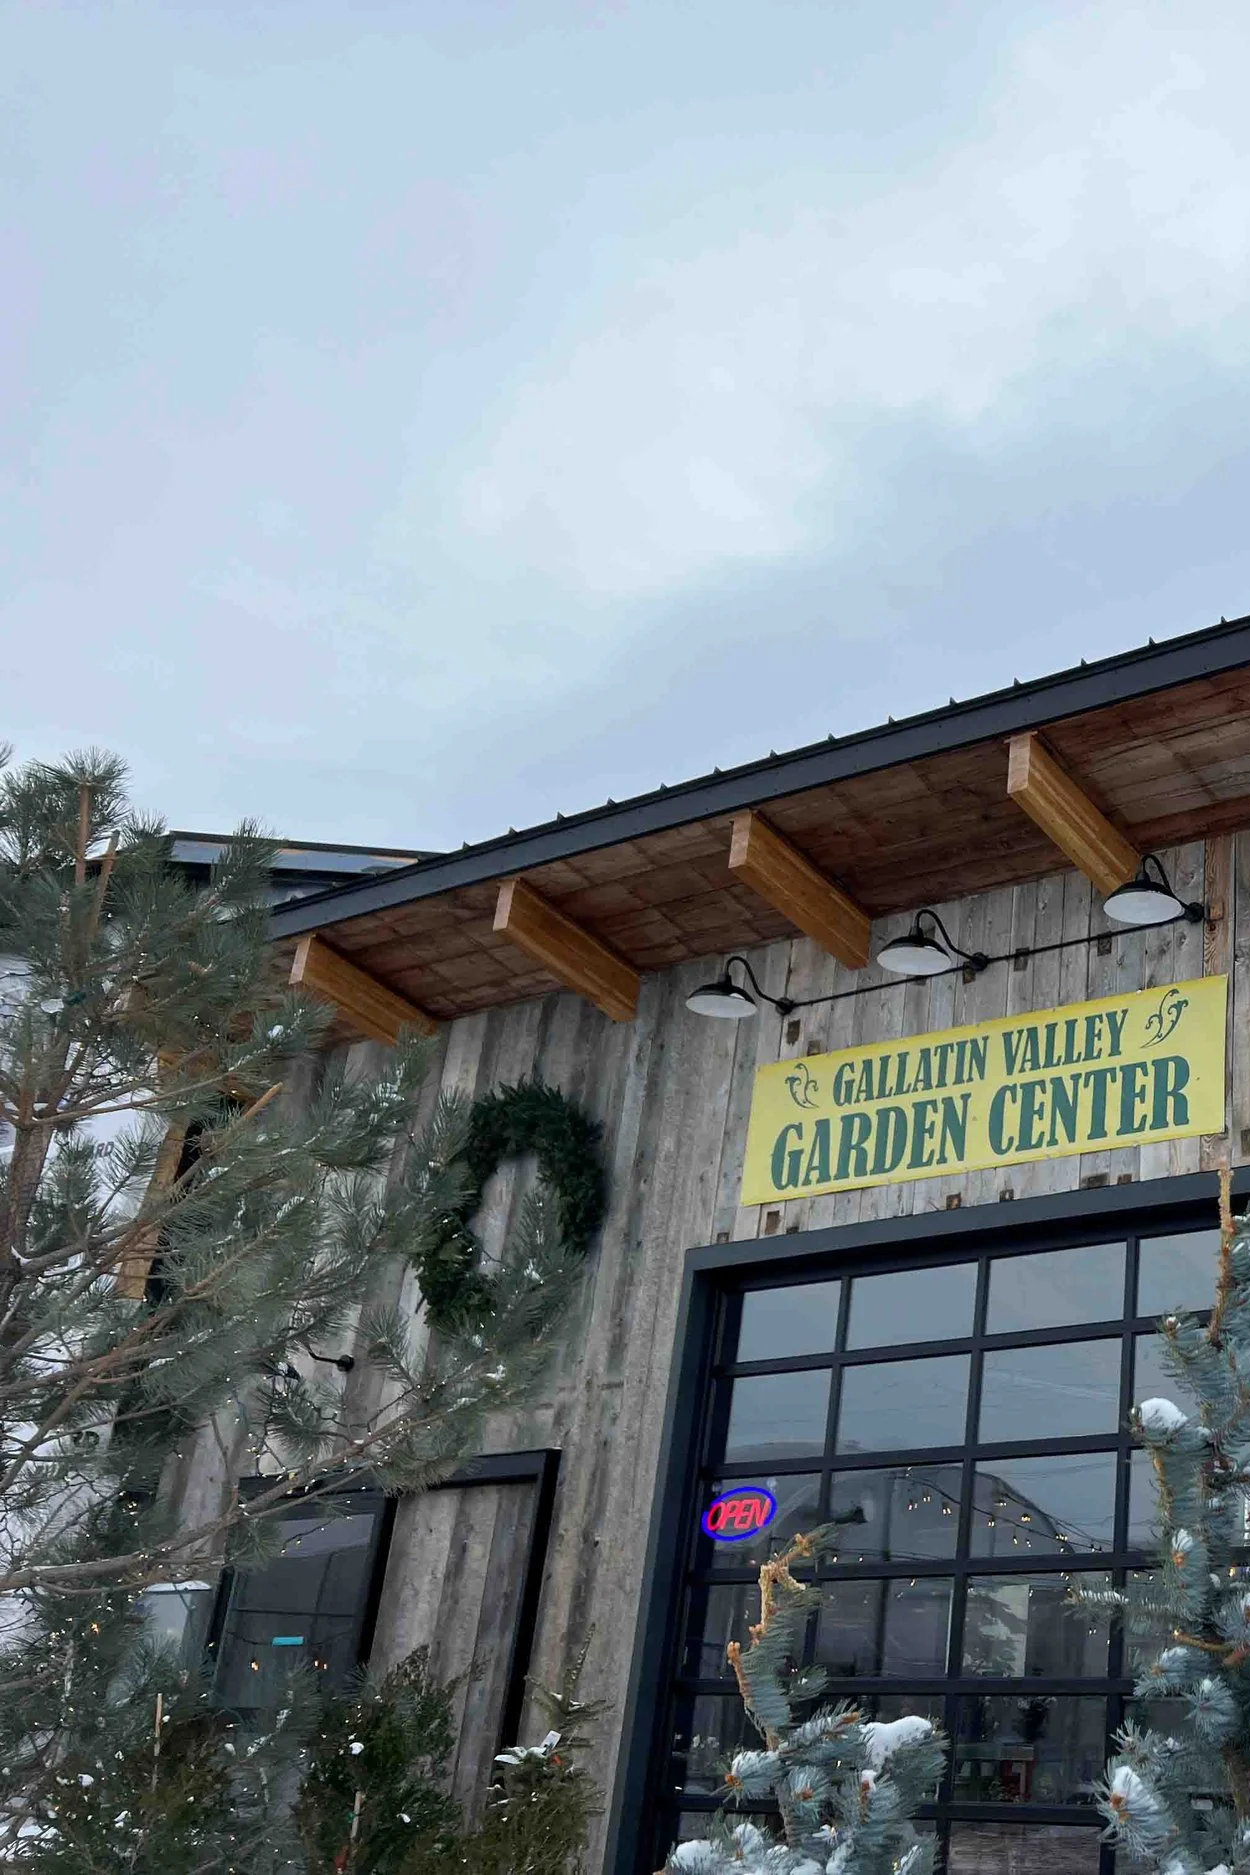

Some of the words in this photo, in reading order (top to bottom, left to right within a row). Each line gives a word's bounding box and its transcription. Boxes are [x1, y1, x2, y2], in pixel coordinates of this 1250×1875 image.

[833, 1036, 989, 1106] GALLATIN
[1002, 1009, 1129, 1076] VALLEY
[771, 1093, 971, 1190] GARDEN
[989, 1056, 1189, 1155] CENTER
[707, 1498, 771, 1531] OPEN
